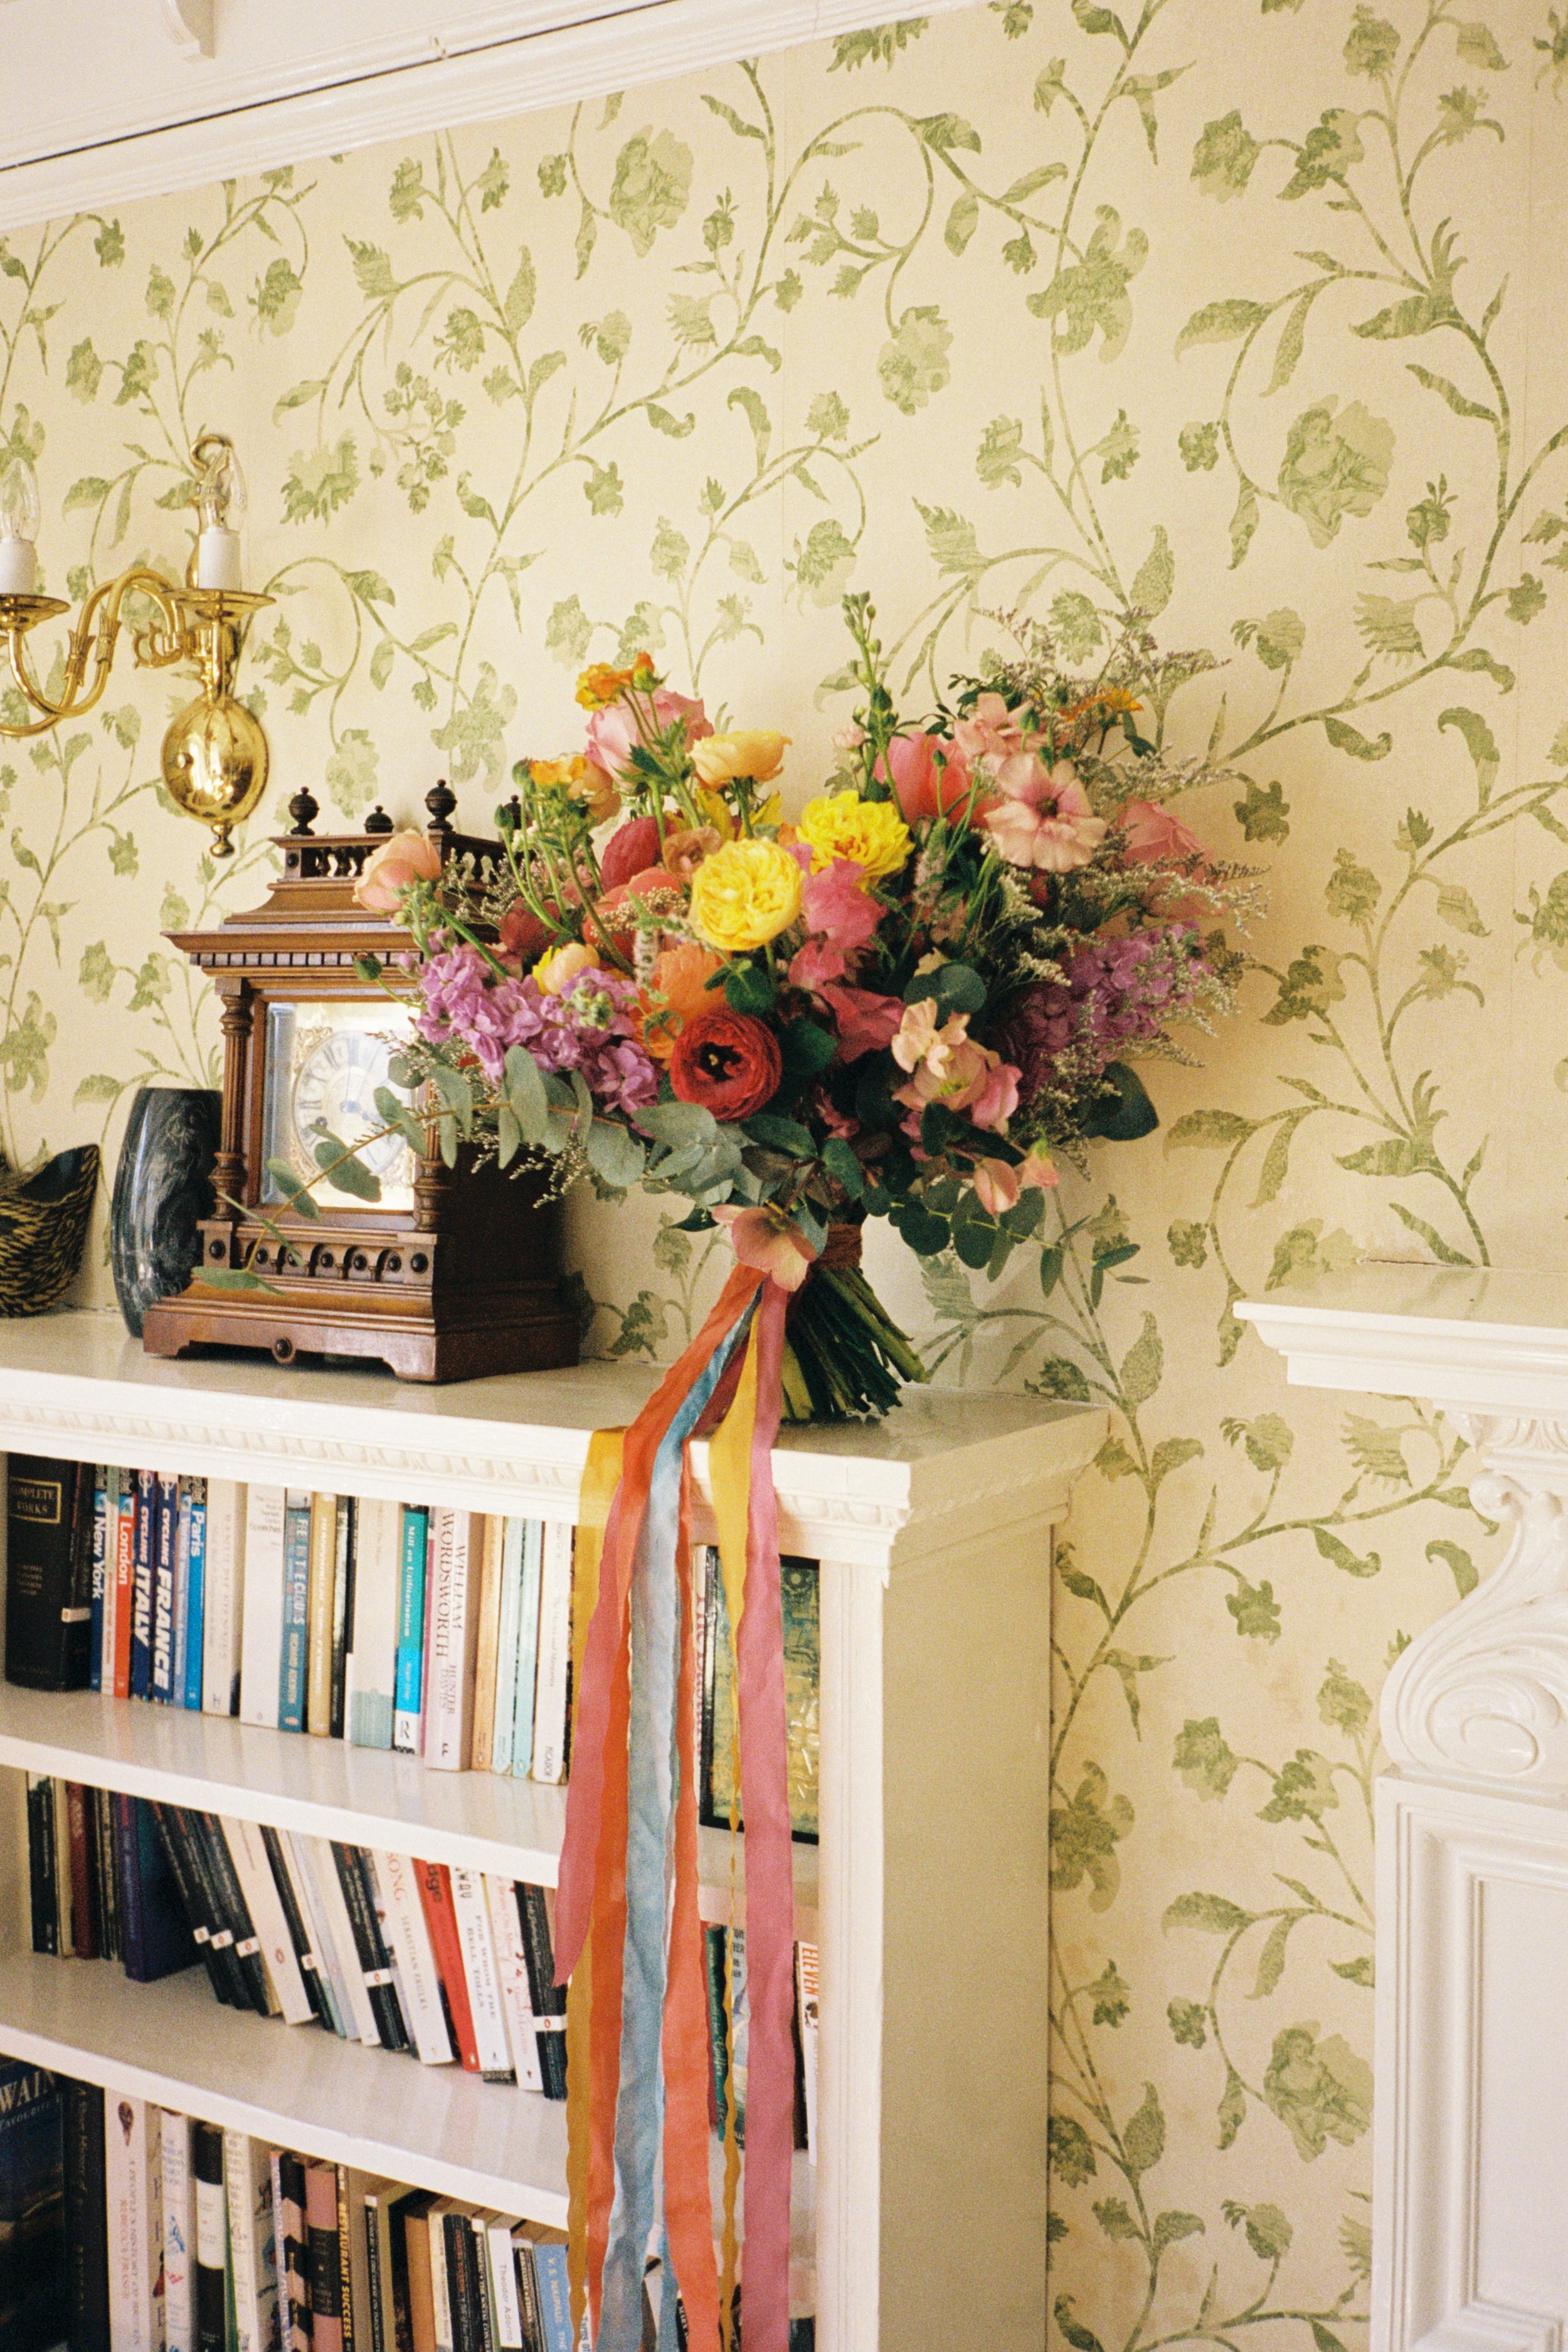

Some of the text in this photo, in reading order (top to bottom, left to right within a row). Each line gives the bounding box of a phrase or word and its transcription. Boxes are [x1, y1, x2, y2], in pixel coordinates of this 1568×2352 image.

[16, 1502, 49, 1514] WORKS
[191, 1510, 203, 1557] Paris
[92, 1517, 107, 1599] New York
[119, 1522, 131, 1585] London
[135, 1506, 150, 1647] CYCLING ITALY
[404, 1526, 415, 1637] Mill on Utilitarianism
[436, 1512, 455, 1657] WORDSWORTH
[452, 1545, 465, 1629] WILLIAM
[154, 1508, 172, 1690] CYCLING FRANCE
[447, 1665, 457, 1714] HUNTER
[544, 1746, 553, 1776] PICADOR
[401, 1916, 418, 1971] SEBASTIAN
[467, 1927, 486, 2008] BELL TOLLS
[475, 1915, 497, 2019] FOR WHOM THE
[802, 1947, 818, 1997] ELEVEN
[339, 2202, 351, 2338] RESTAURANT SUCCESS
[499, 2264, 515, 2341] Theodor Adorno
[551, 2279, 562, 2323] NAIPAUL
